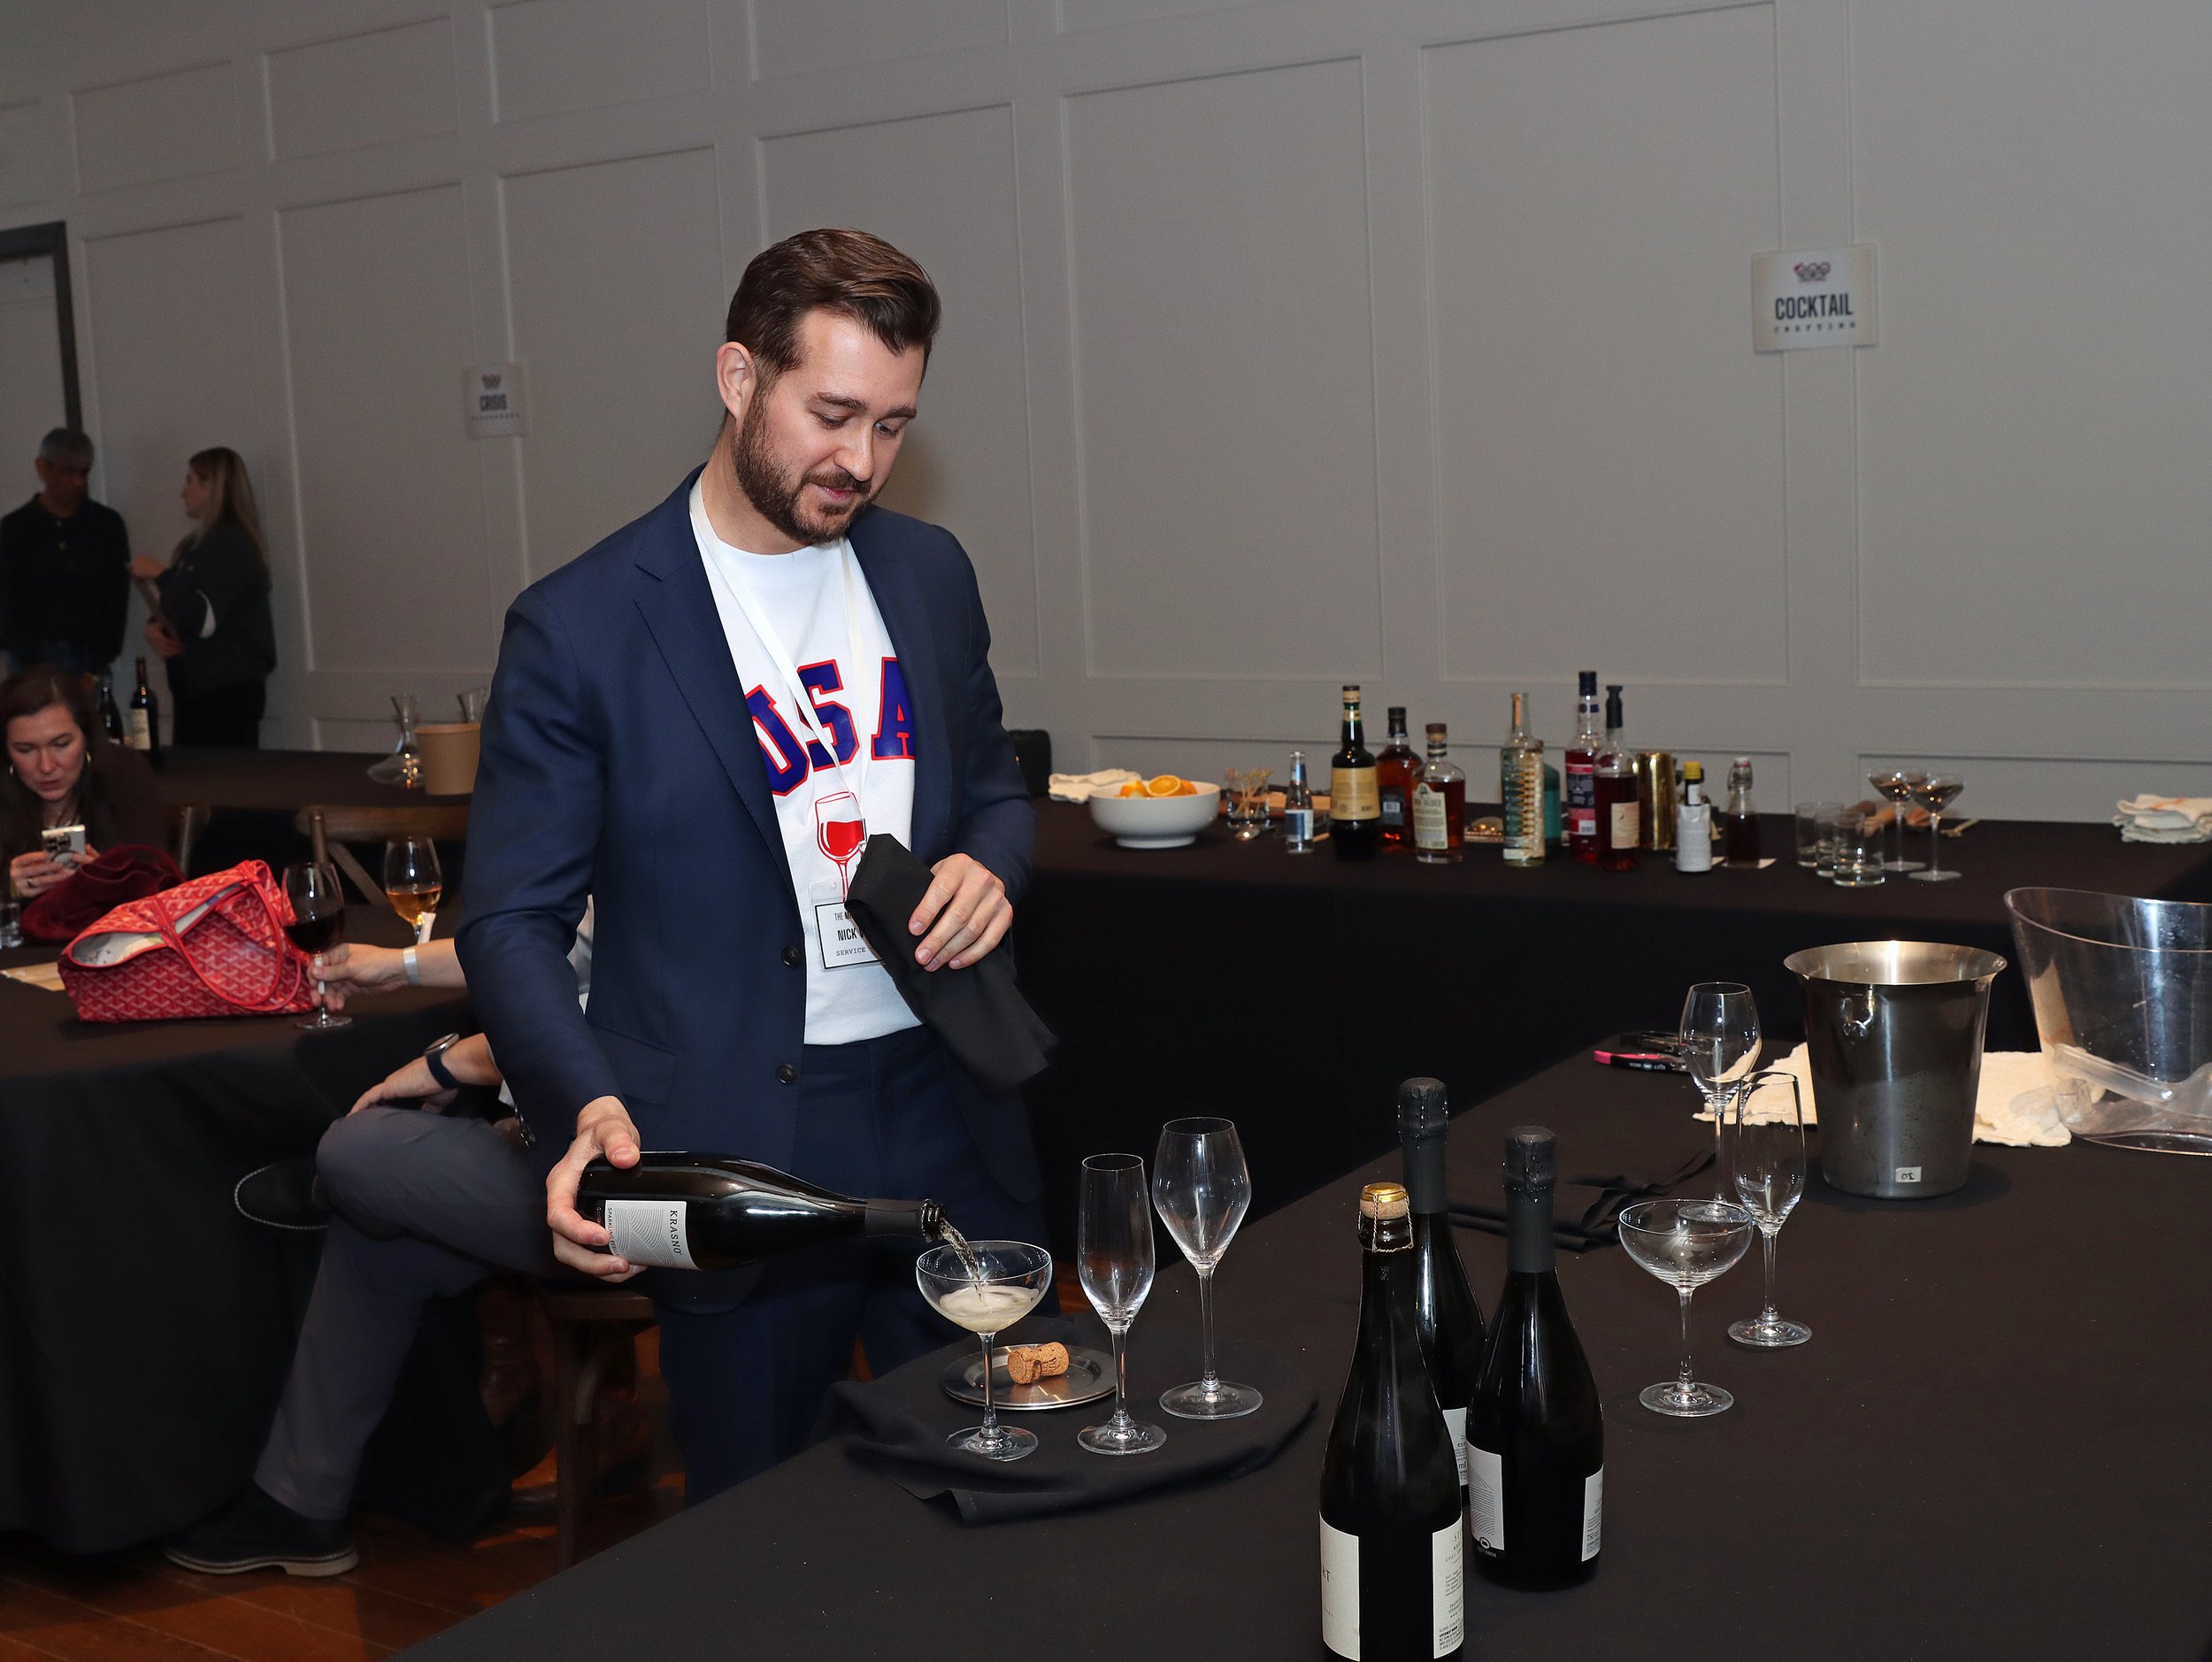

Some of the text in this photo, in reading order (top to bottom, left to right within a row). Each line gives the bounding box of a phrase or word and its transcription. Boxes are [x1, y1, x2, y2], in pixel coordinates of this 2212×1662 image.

[1775, 293, 1853, 320] COCKTAIL
[745, 657, 916, 796] USA
[837, 927, 857, 942] NICK
[836, 947, 866, 956] SERVICE
[670, 1210, 682, 1255] KRASNO
